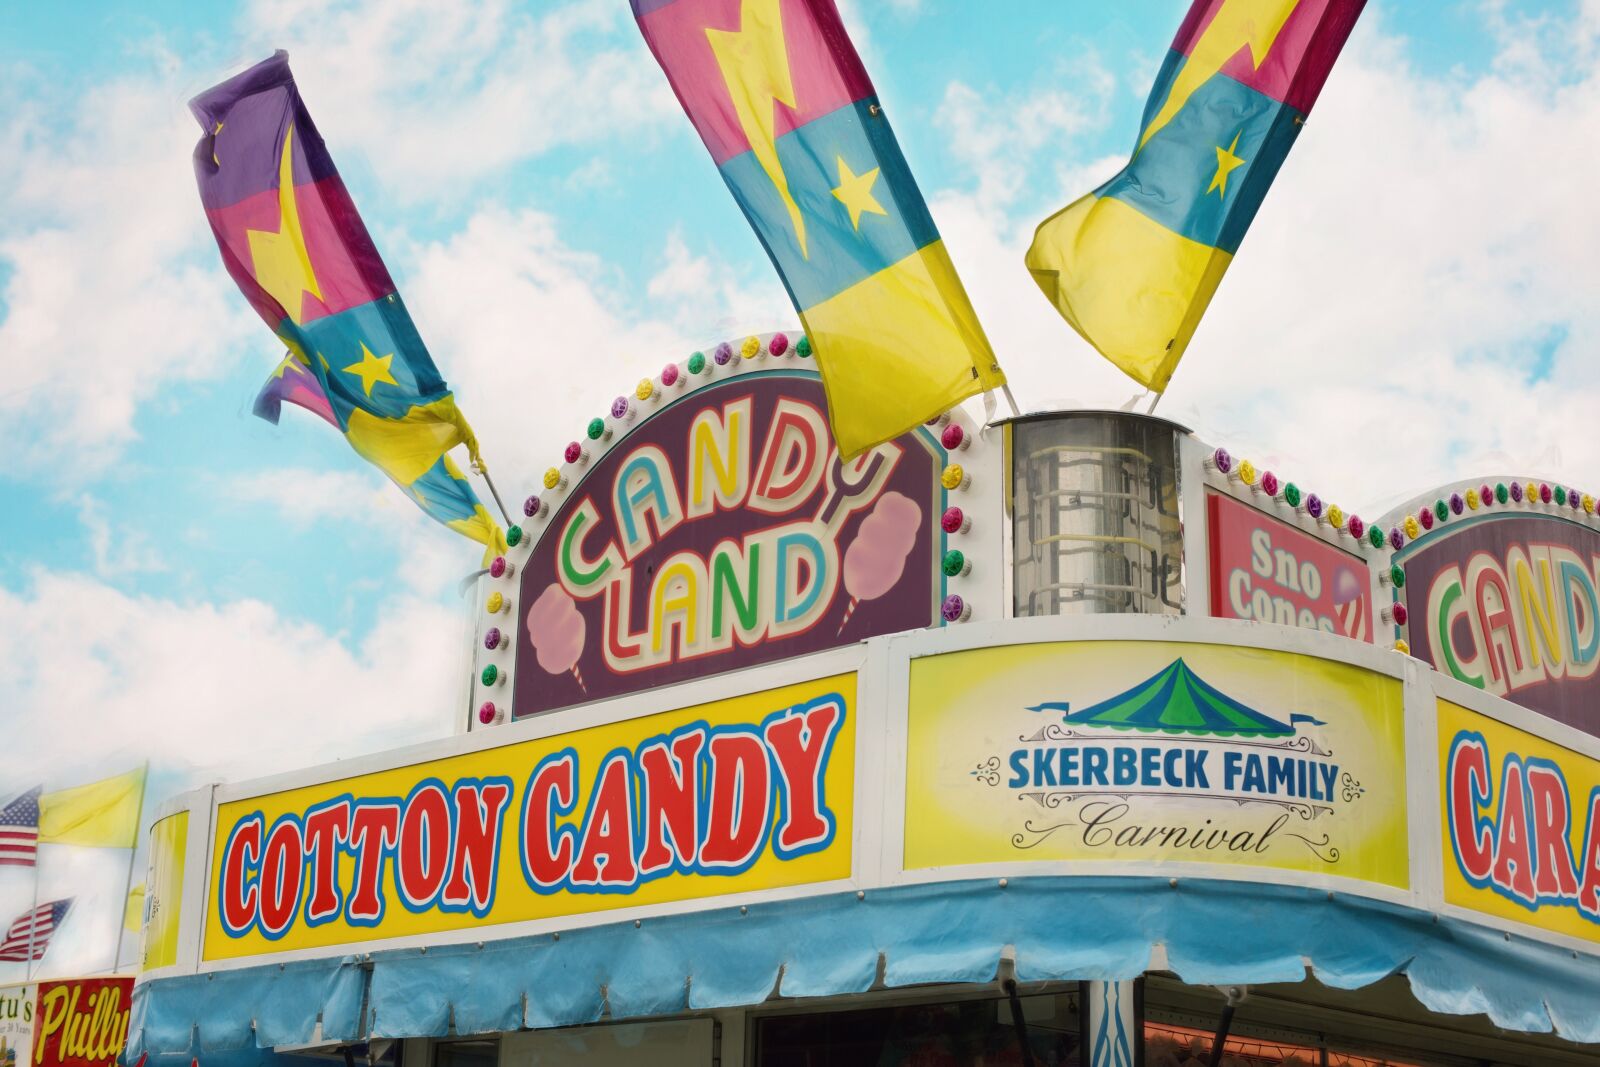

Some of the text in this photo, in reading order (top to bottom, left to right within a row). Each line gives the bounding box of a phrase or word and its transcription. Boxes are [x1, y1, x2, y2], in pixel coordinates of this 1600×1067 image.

[556, 396, 902, 598] CANDY
[601, 517, 842, 676] LAND
[1251, 528, 1322, 600] Sno
[1427, 541, 1600, 698] CAND
[220, 692, 846, 941] COTTON CANDY
[1008, 747, 1340, 803] SKERBECK FAMILY
[1078, 800, 1290, 855] Carnival
[35, 984, 130, 1067] Philly
